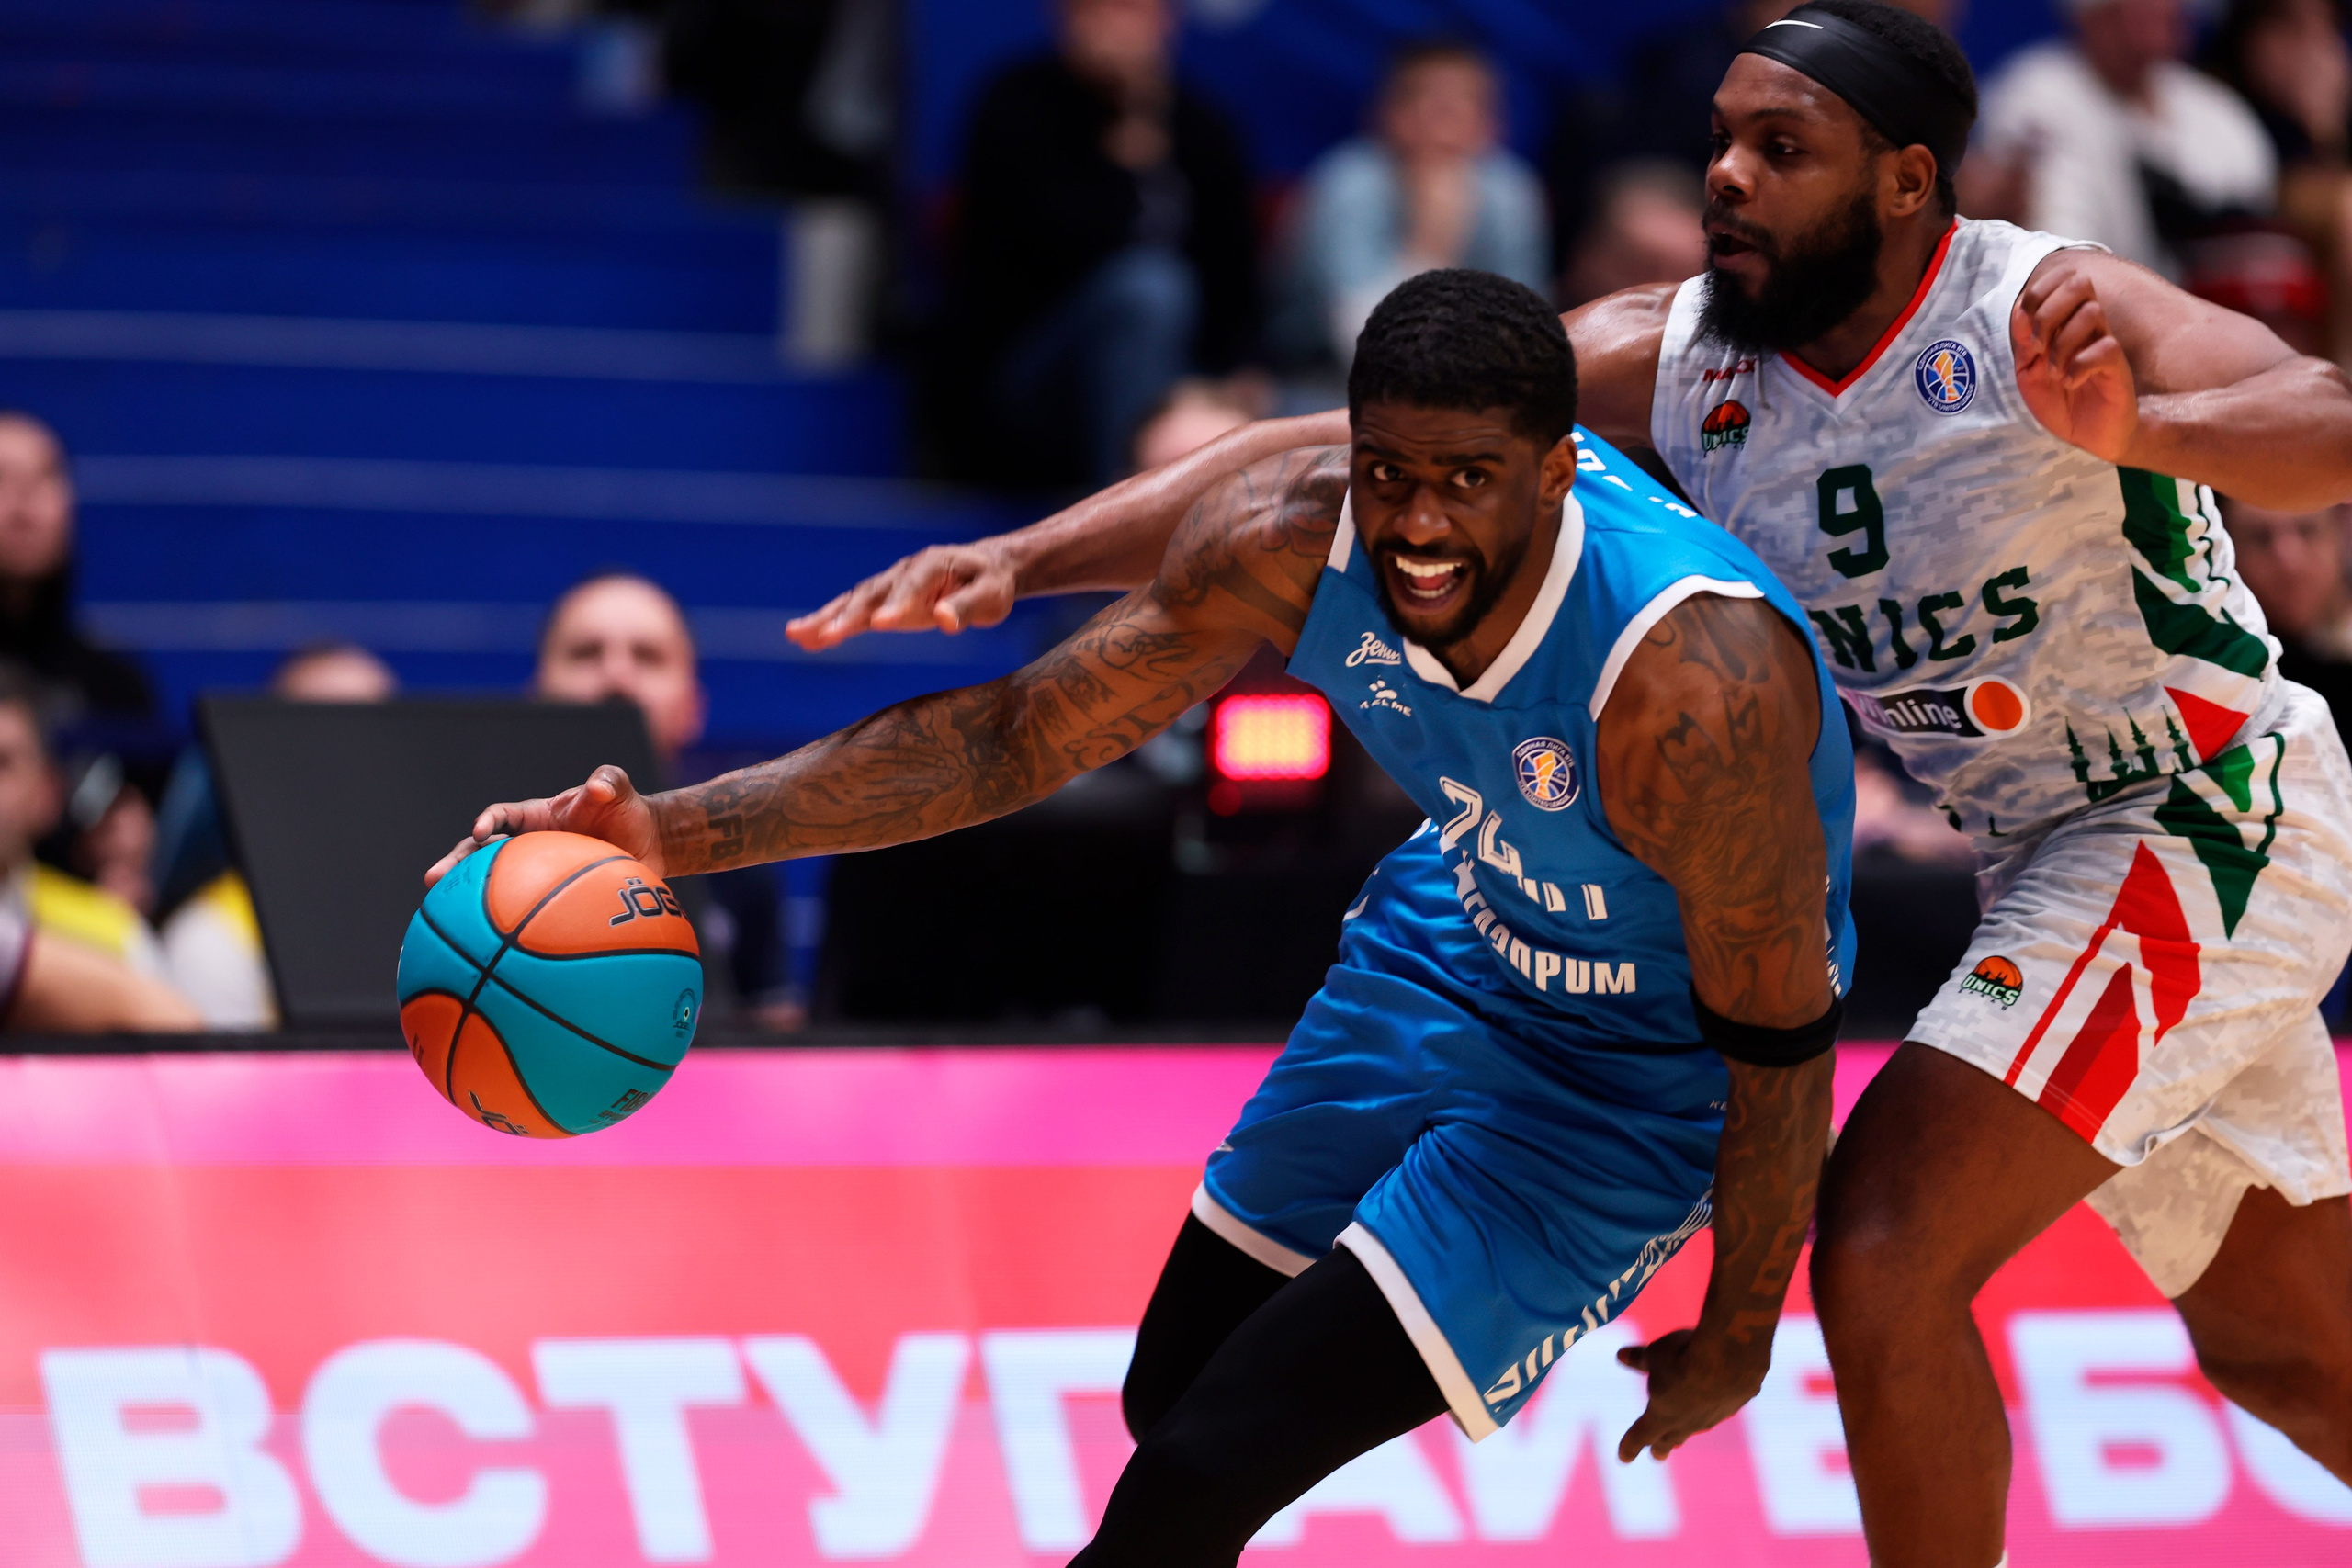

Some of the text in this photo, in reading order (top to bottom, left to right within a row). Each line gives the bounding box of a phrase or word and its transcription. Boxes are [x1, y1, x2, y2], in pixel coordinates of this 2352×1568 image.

[1818, 464, 1890, 579] 9
[1810, 566, 2040, 672] NICS
[1961, 973, 2020, 1007] UNICS
